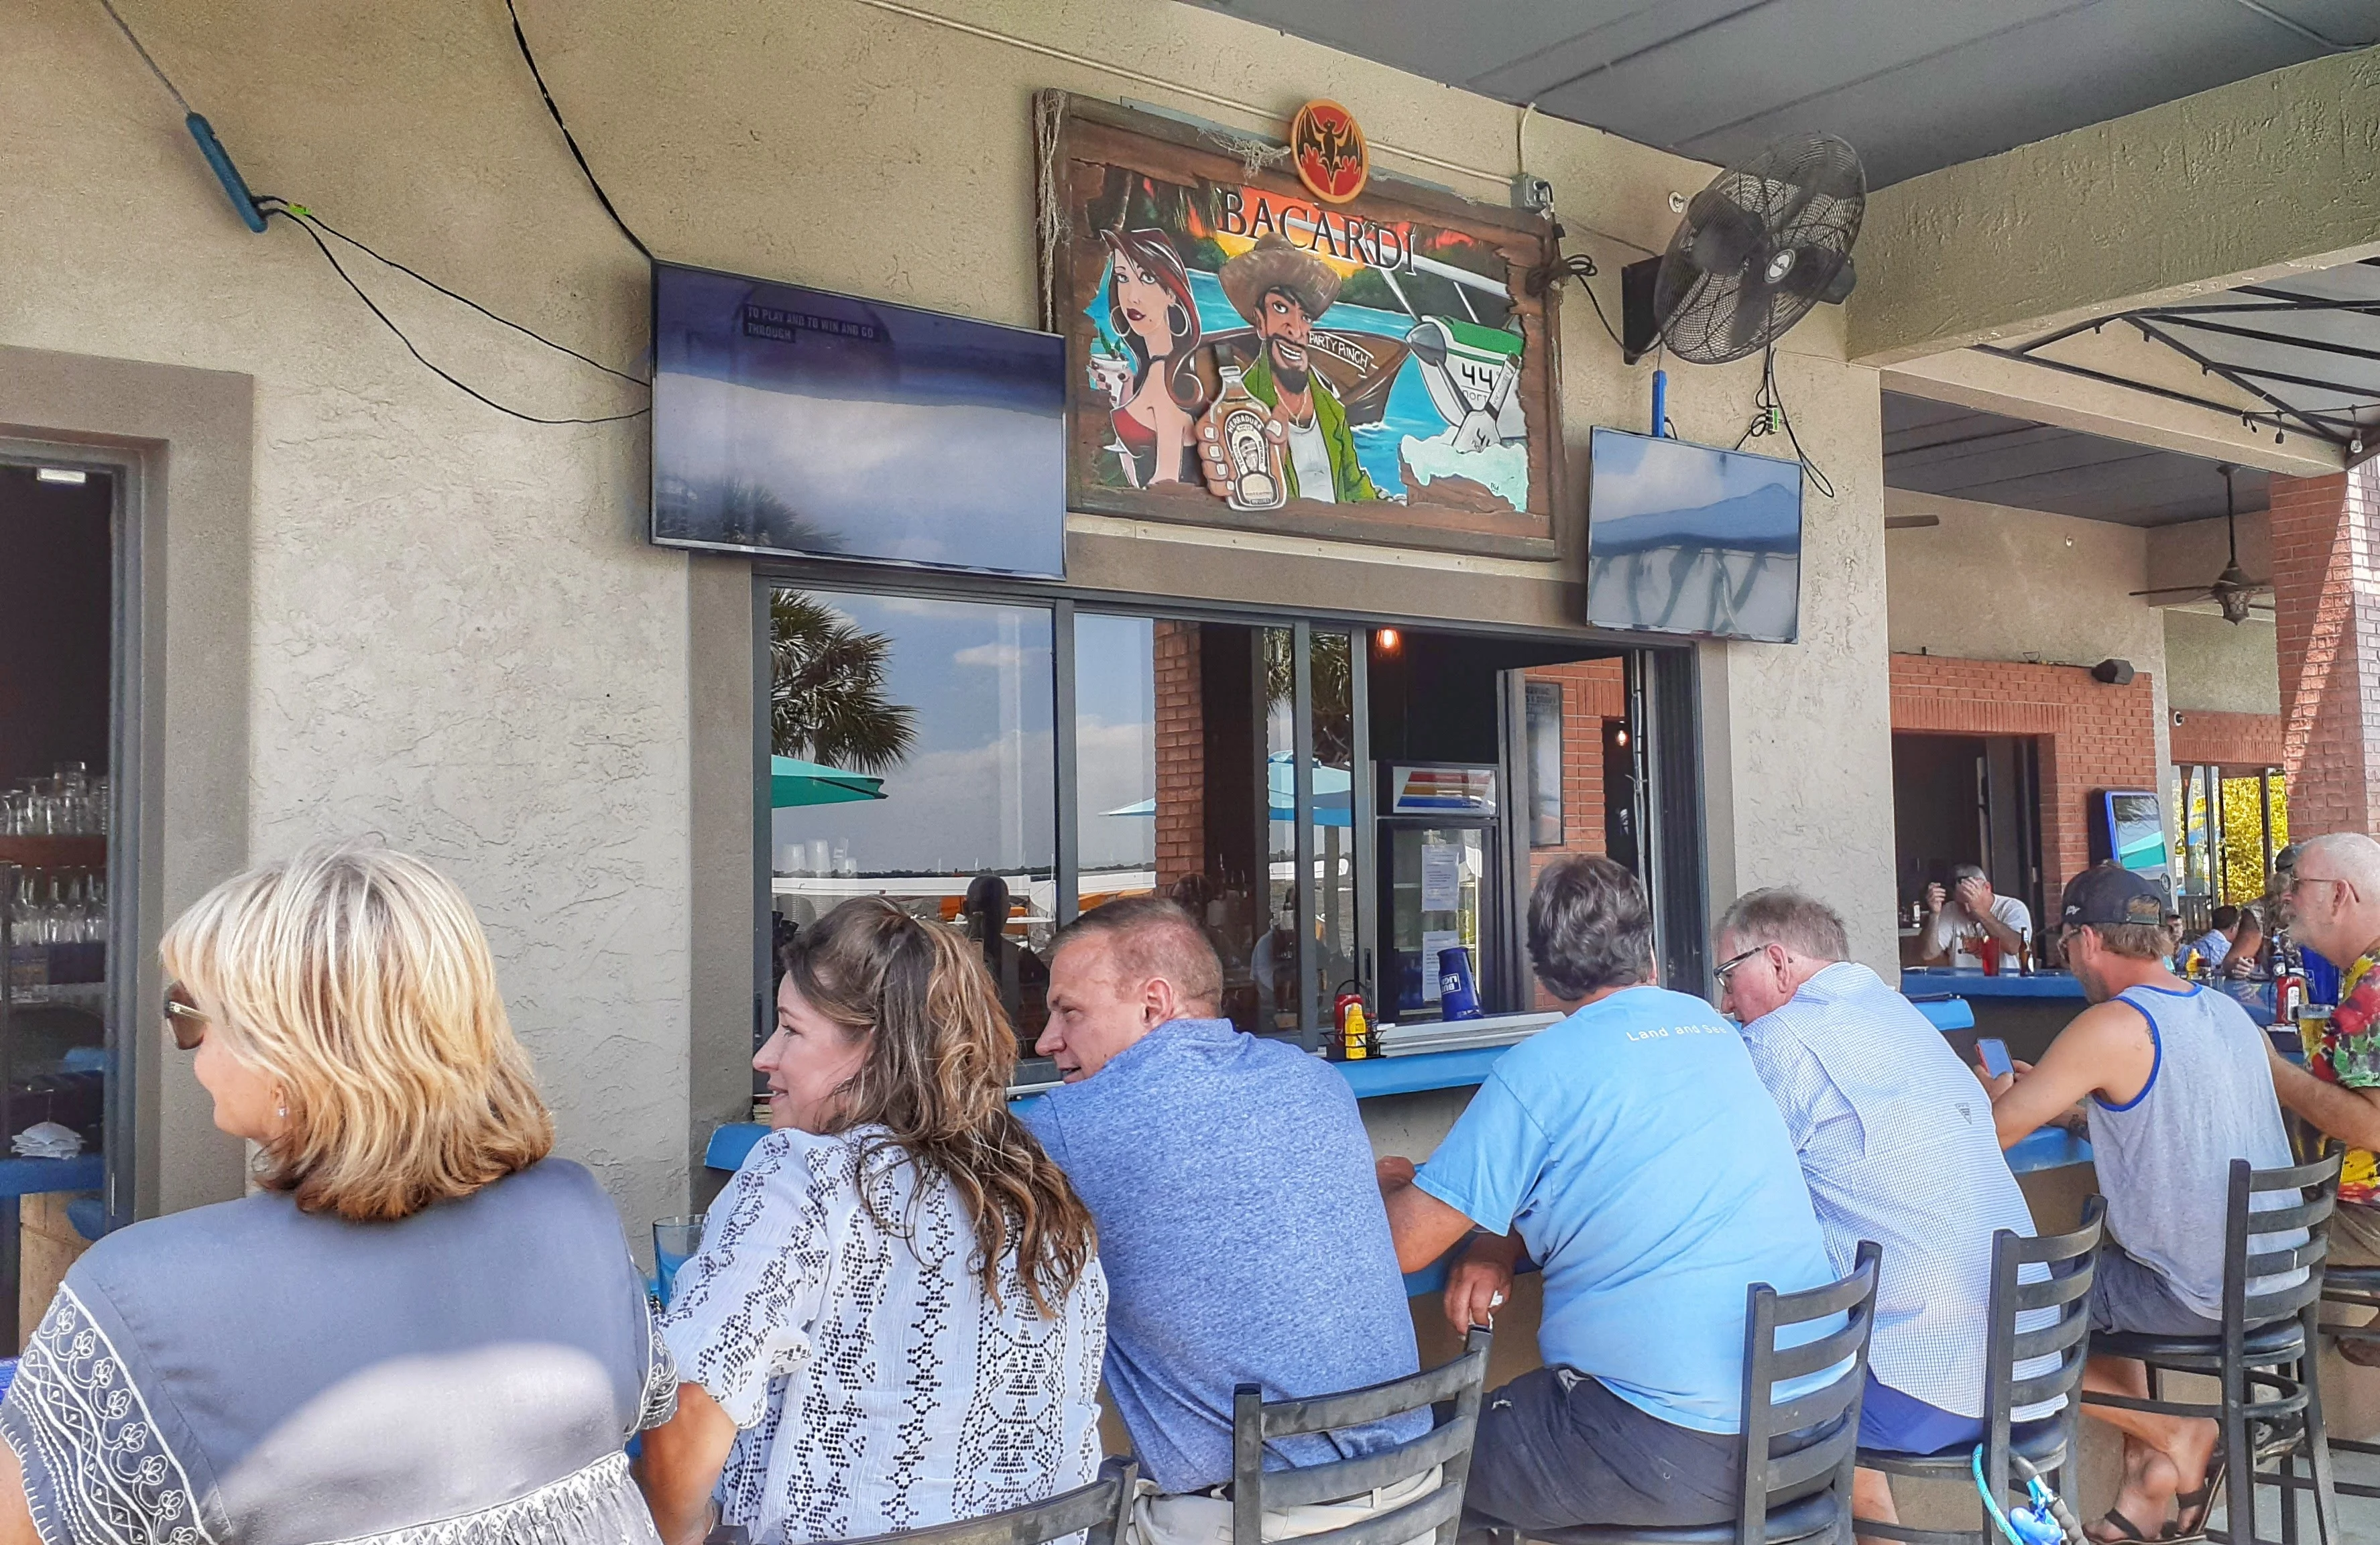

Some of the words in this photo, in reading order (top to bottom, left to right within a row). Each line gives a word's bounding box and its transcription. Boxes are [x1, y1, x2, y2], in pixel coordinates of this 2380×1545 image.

[748, 306, 759, 318] TO
[762, 308, 784, 322] PLAY
[786, 313, 804, 326] AND
[807, 316, 819, 328] TO
[821, 319, 838, 332] WIN
[841, 324, 859, 336] AND
[748, 322, 791, 340] THROUGH
[1309, 333, 1337, 351] PARTY
[1227, 414, 1262, 434] HERRADURA
[1442, 975, 1457, 985] LIG
[1626, 1026, 1669, 1042] Land
[1675, 1024, 1701, 1035] and
